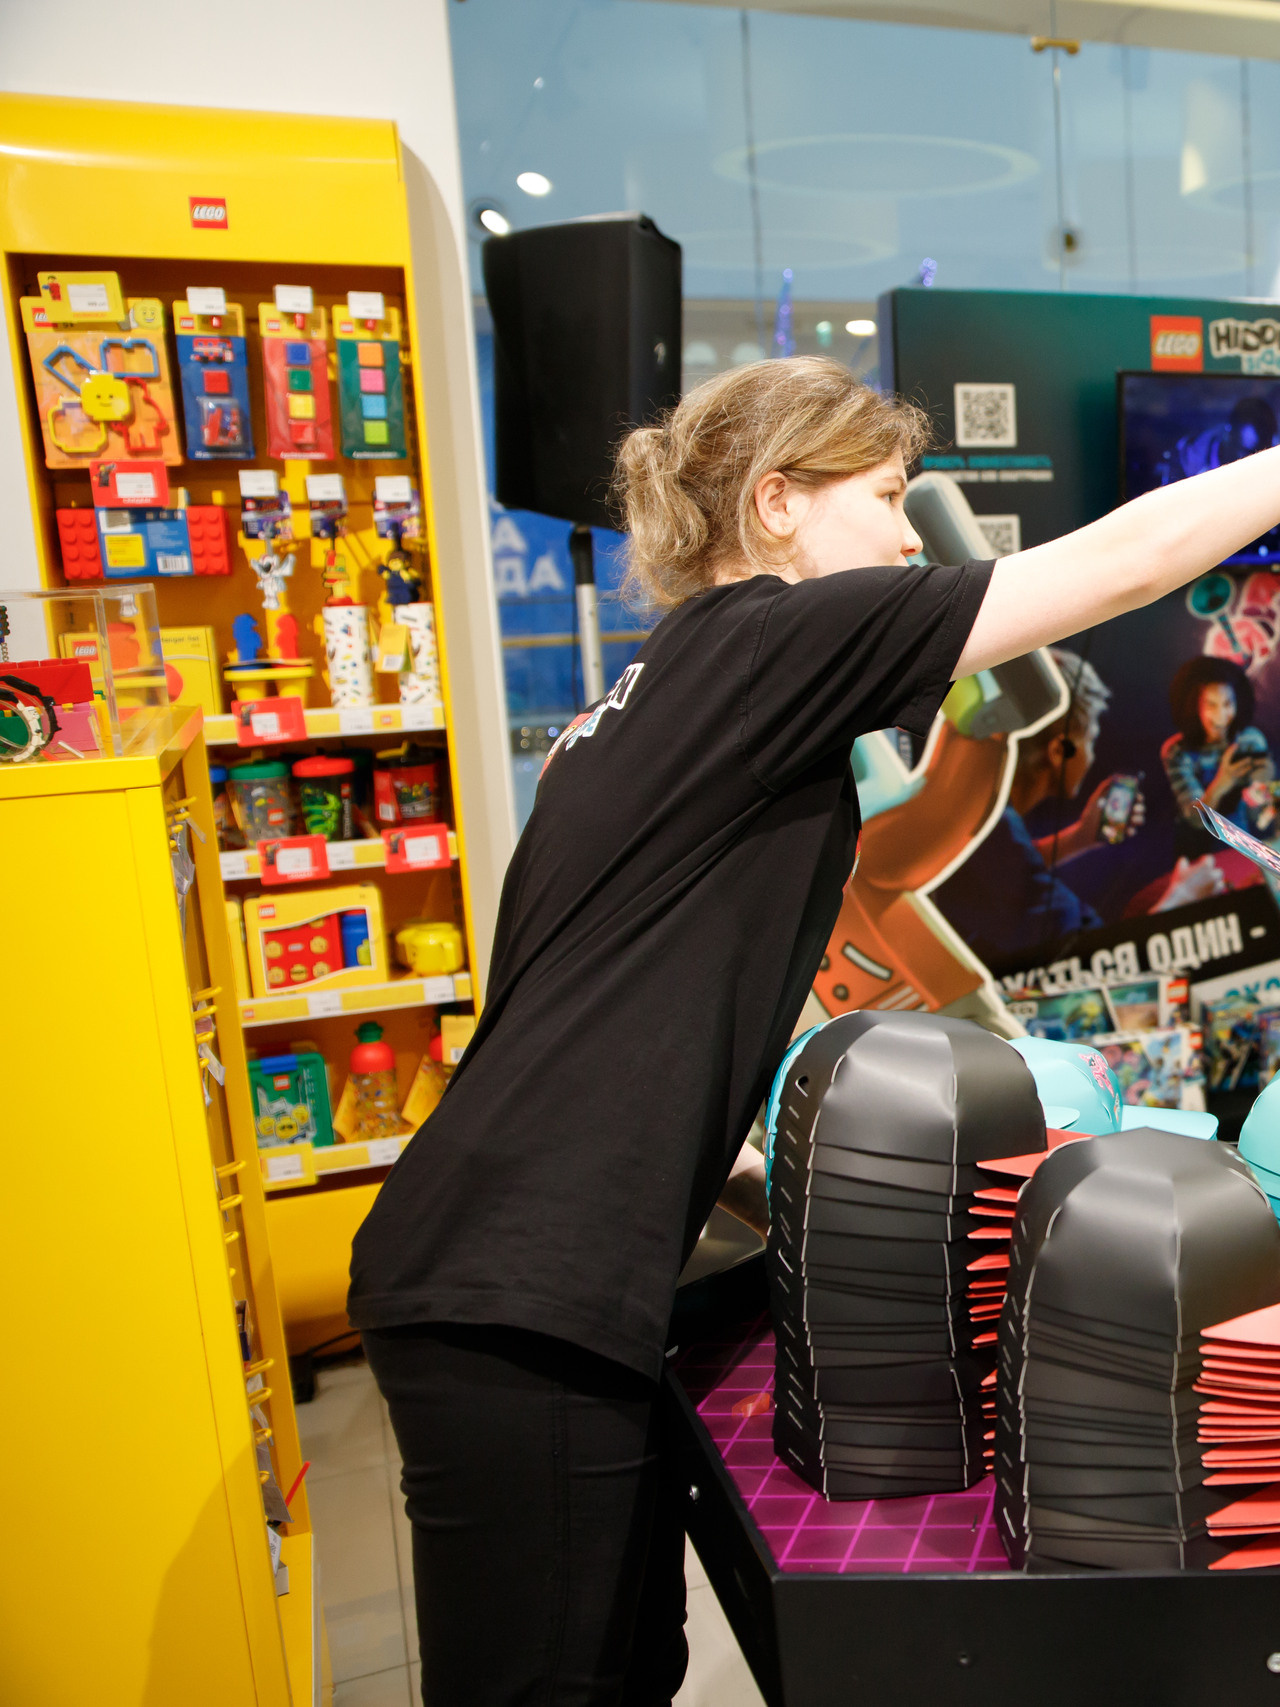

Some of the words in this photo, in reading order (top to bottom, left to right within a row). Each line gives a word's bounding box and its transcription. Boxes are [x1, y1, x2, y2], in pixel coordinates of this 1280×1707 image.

[192, 205, 225, 220] LEGO
[1155, 333, 1200, 356] LEGO
[74, 646, 97, 656] LEGO
[1146, 912, 1243, 972] ОДИН
